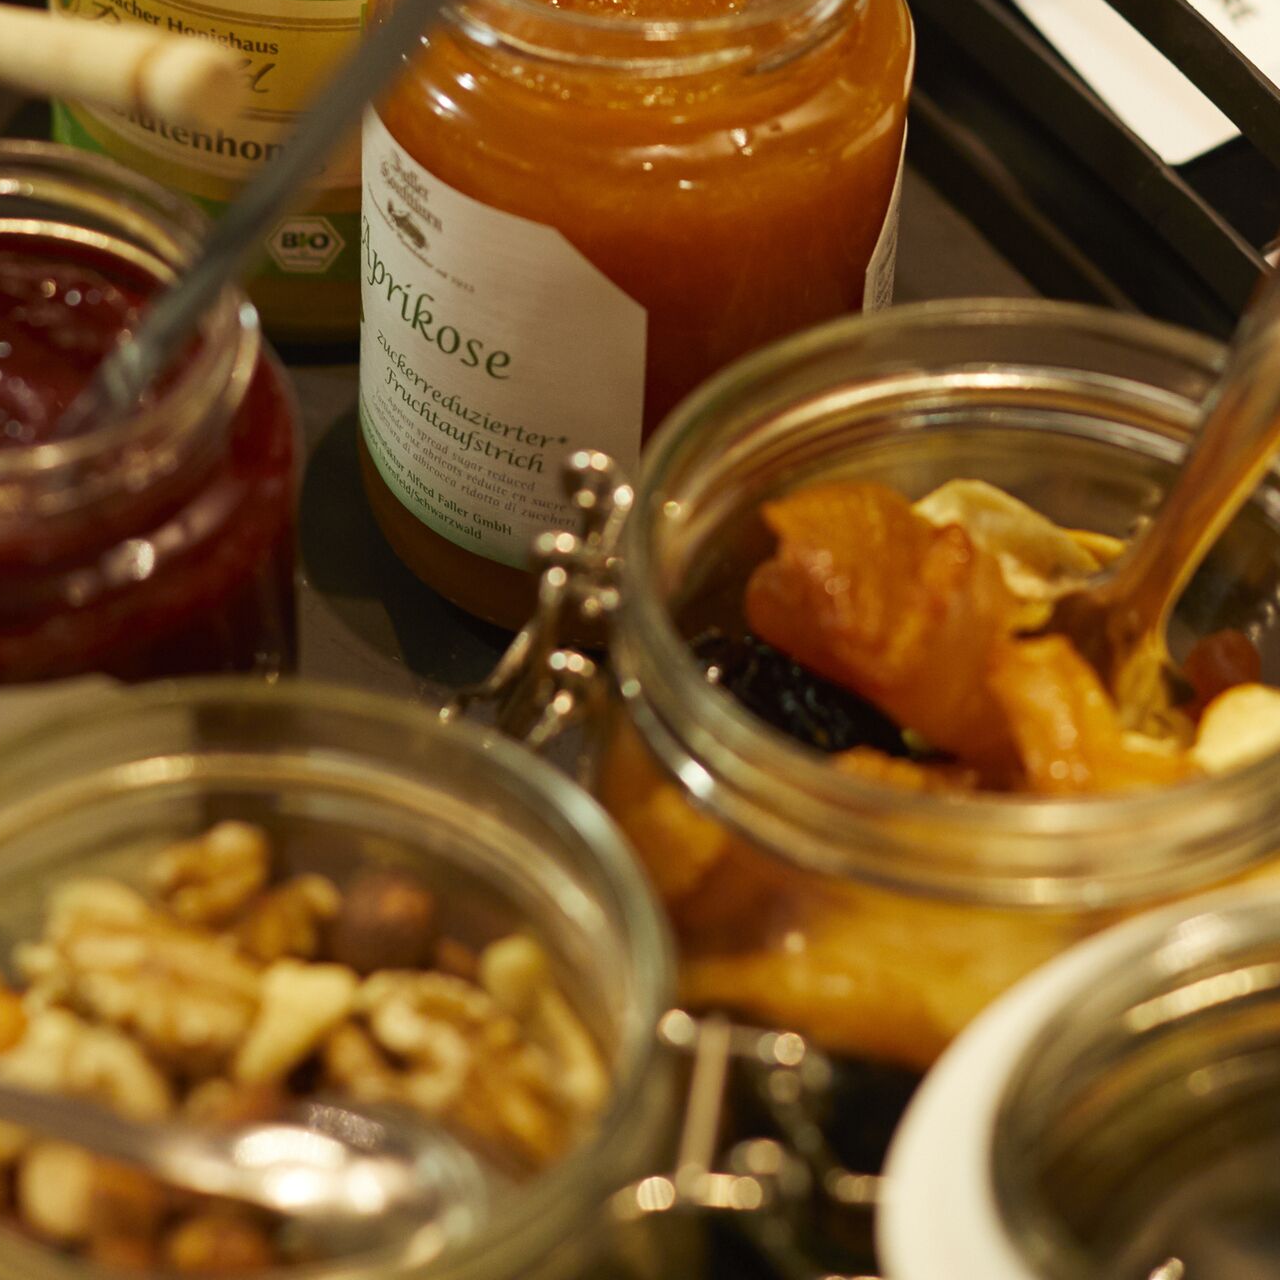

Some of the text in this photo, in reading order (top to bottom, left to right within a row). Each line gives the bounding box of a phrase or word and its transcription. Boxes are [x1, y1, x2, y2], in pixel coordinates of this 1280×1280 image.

[361, 214, 512, 380] Aprikose
[385, 366, 545, 473] Fruchtaufstrich
[406, 465, 513, 536] Alfred Faller GmbH
